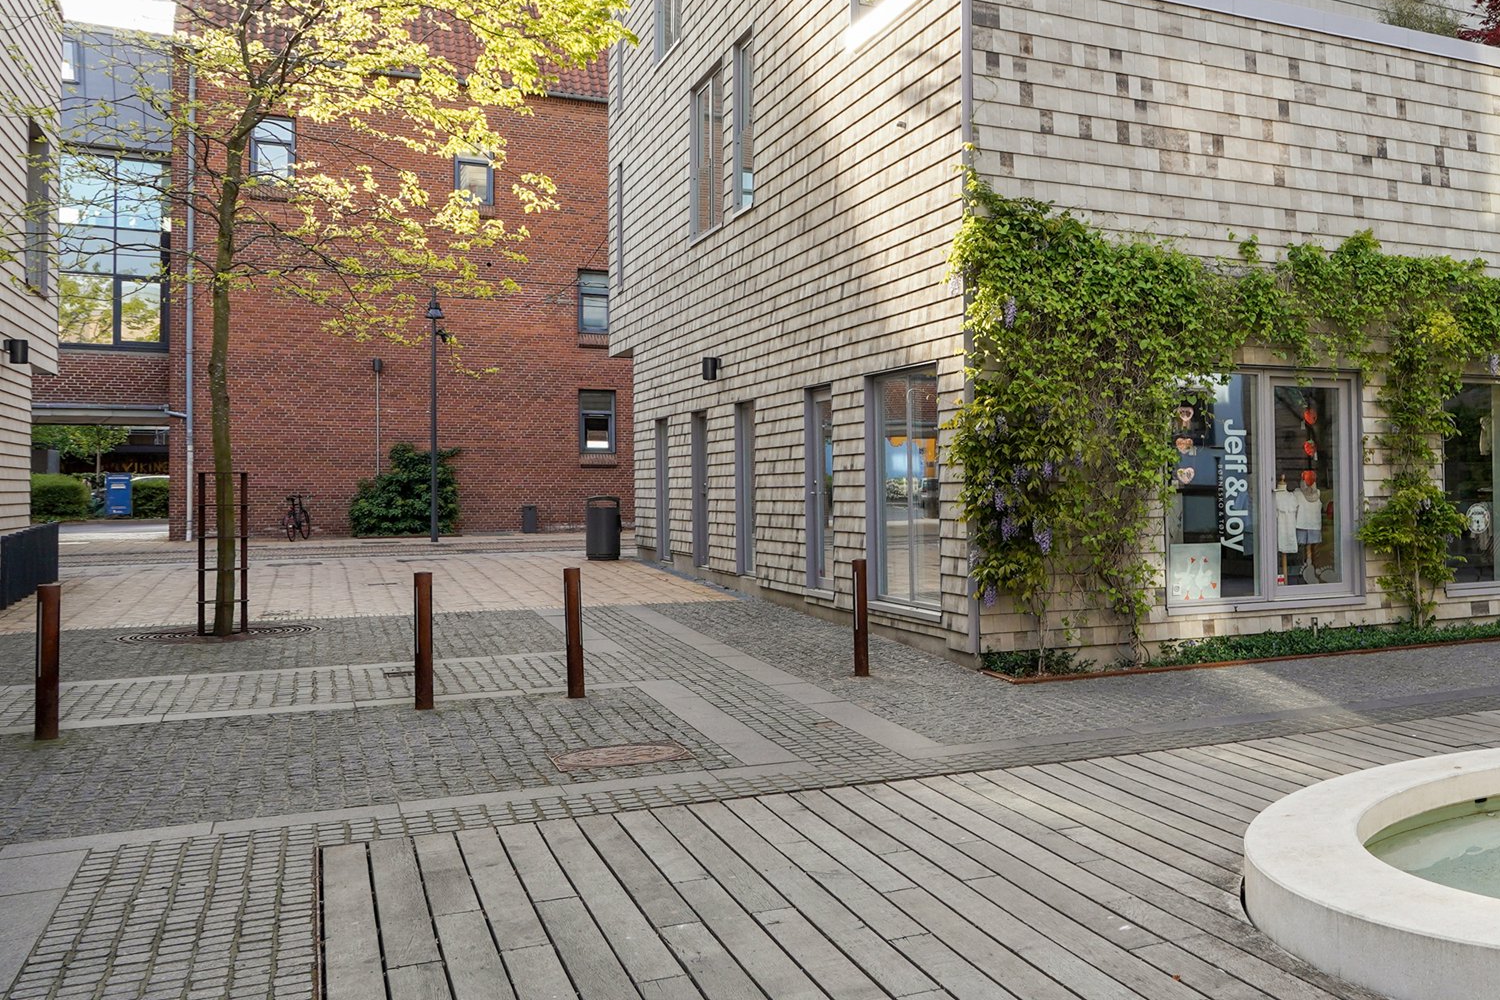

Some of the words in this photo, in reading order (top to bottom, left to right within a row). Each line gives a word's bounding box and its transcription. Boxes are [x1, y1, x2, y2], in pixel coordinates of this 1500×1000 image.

[1223, 419, 1247, 473] Jeff
[1225, 476, 1248, 498] &
[1221, 500, 1248, 552] Joy
